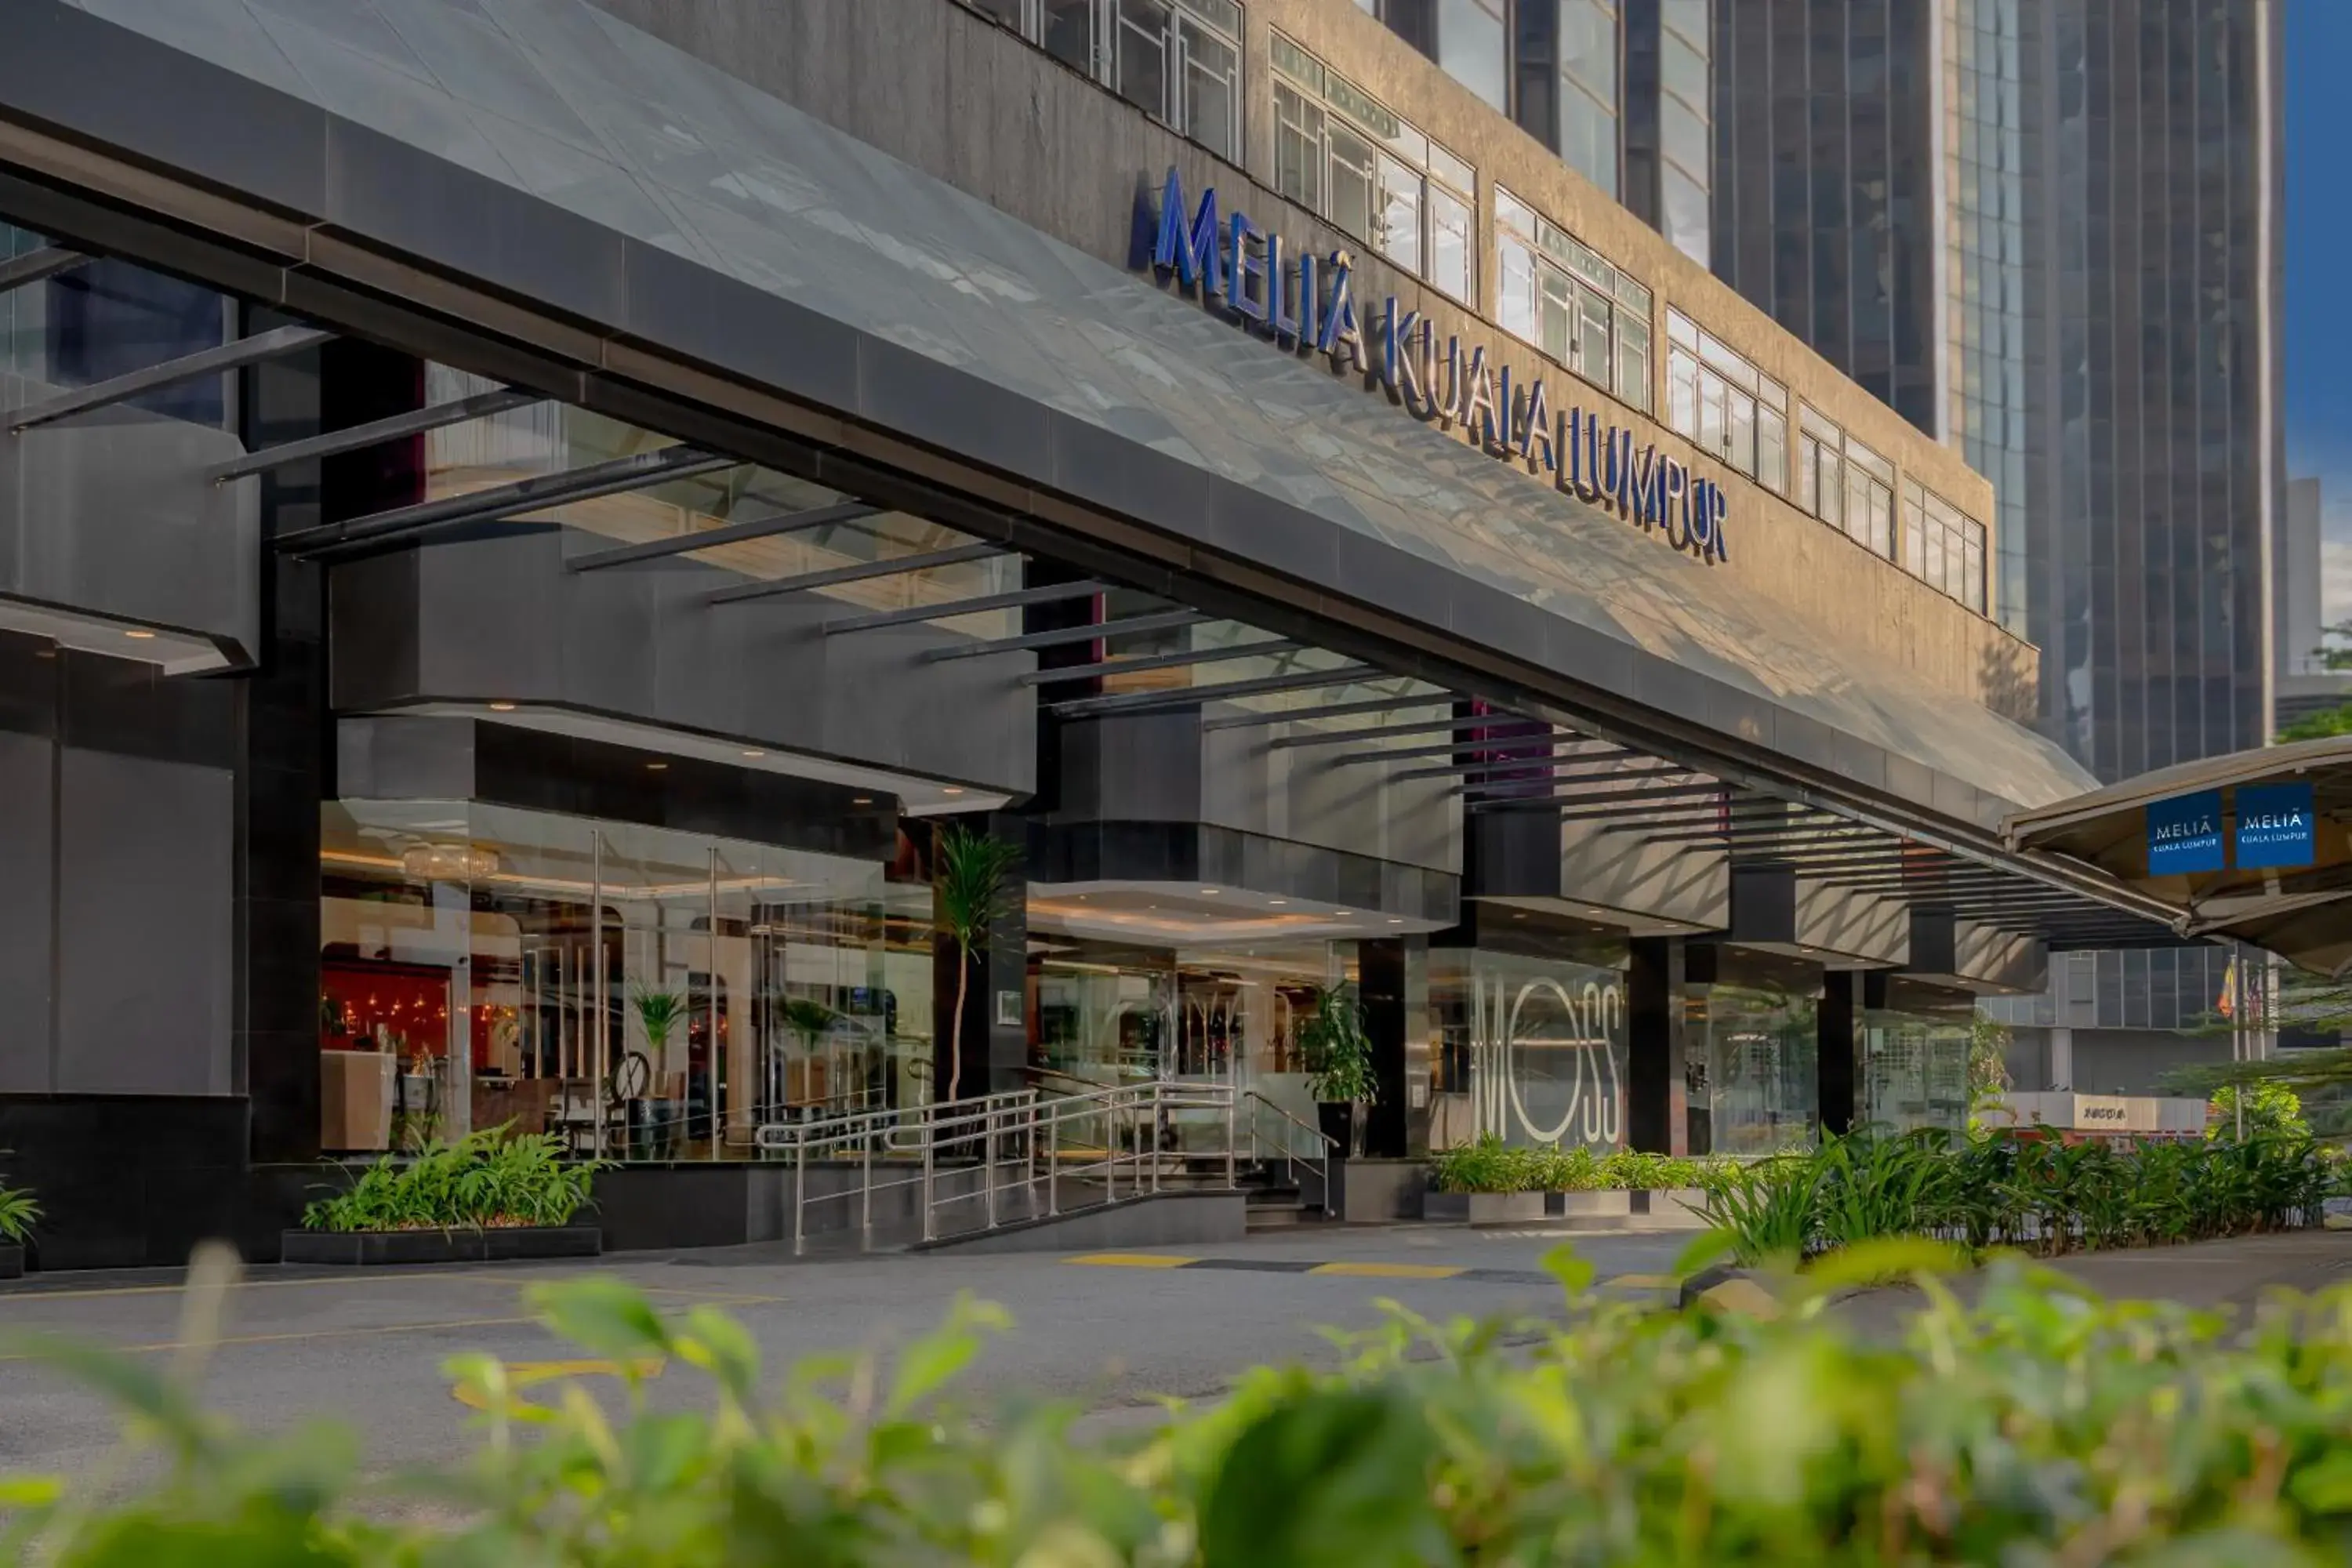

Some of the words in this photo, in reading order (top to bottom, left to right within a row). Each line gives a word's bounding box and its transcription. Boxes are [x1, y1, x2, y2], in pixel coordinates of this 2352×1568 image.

[1385, 296, 1557, 470] KUALA
[1571, 405, 1728, 563] LUMPUR
[2241, 833, 2270, 844] KUALA
[2271, 832, 2308, 841] LUMPUR
[1475, 975, 1621, 1143] MOSS
